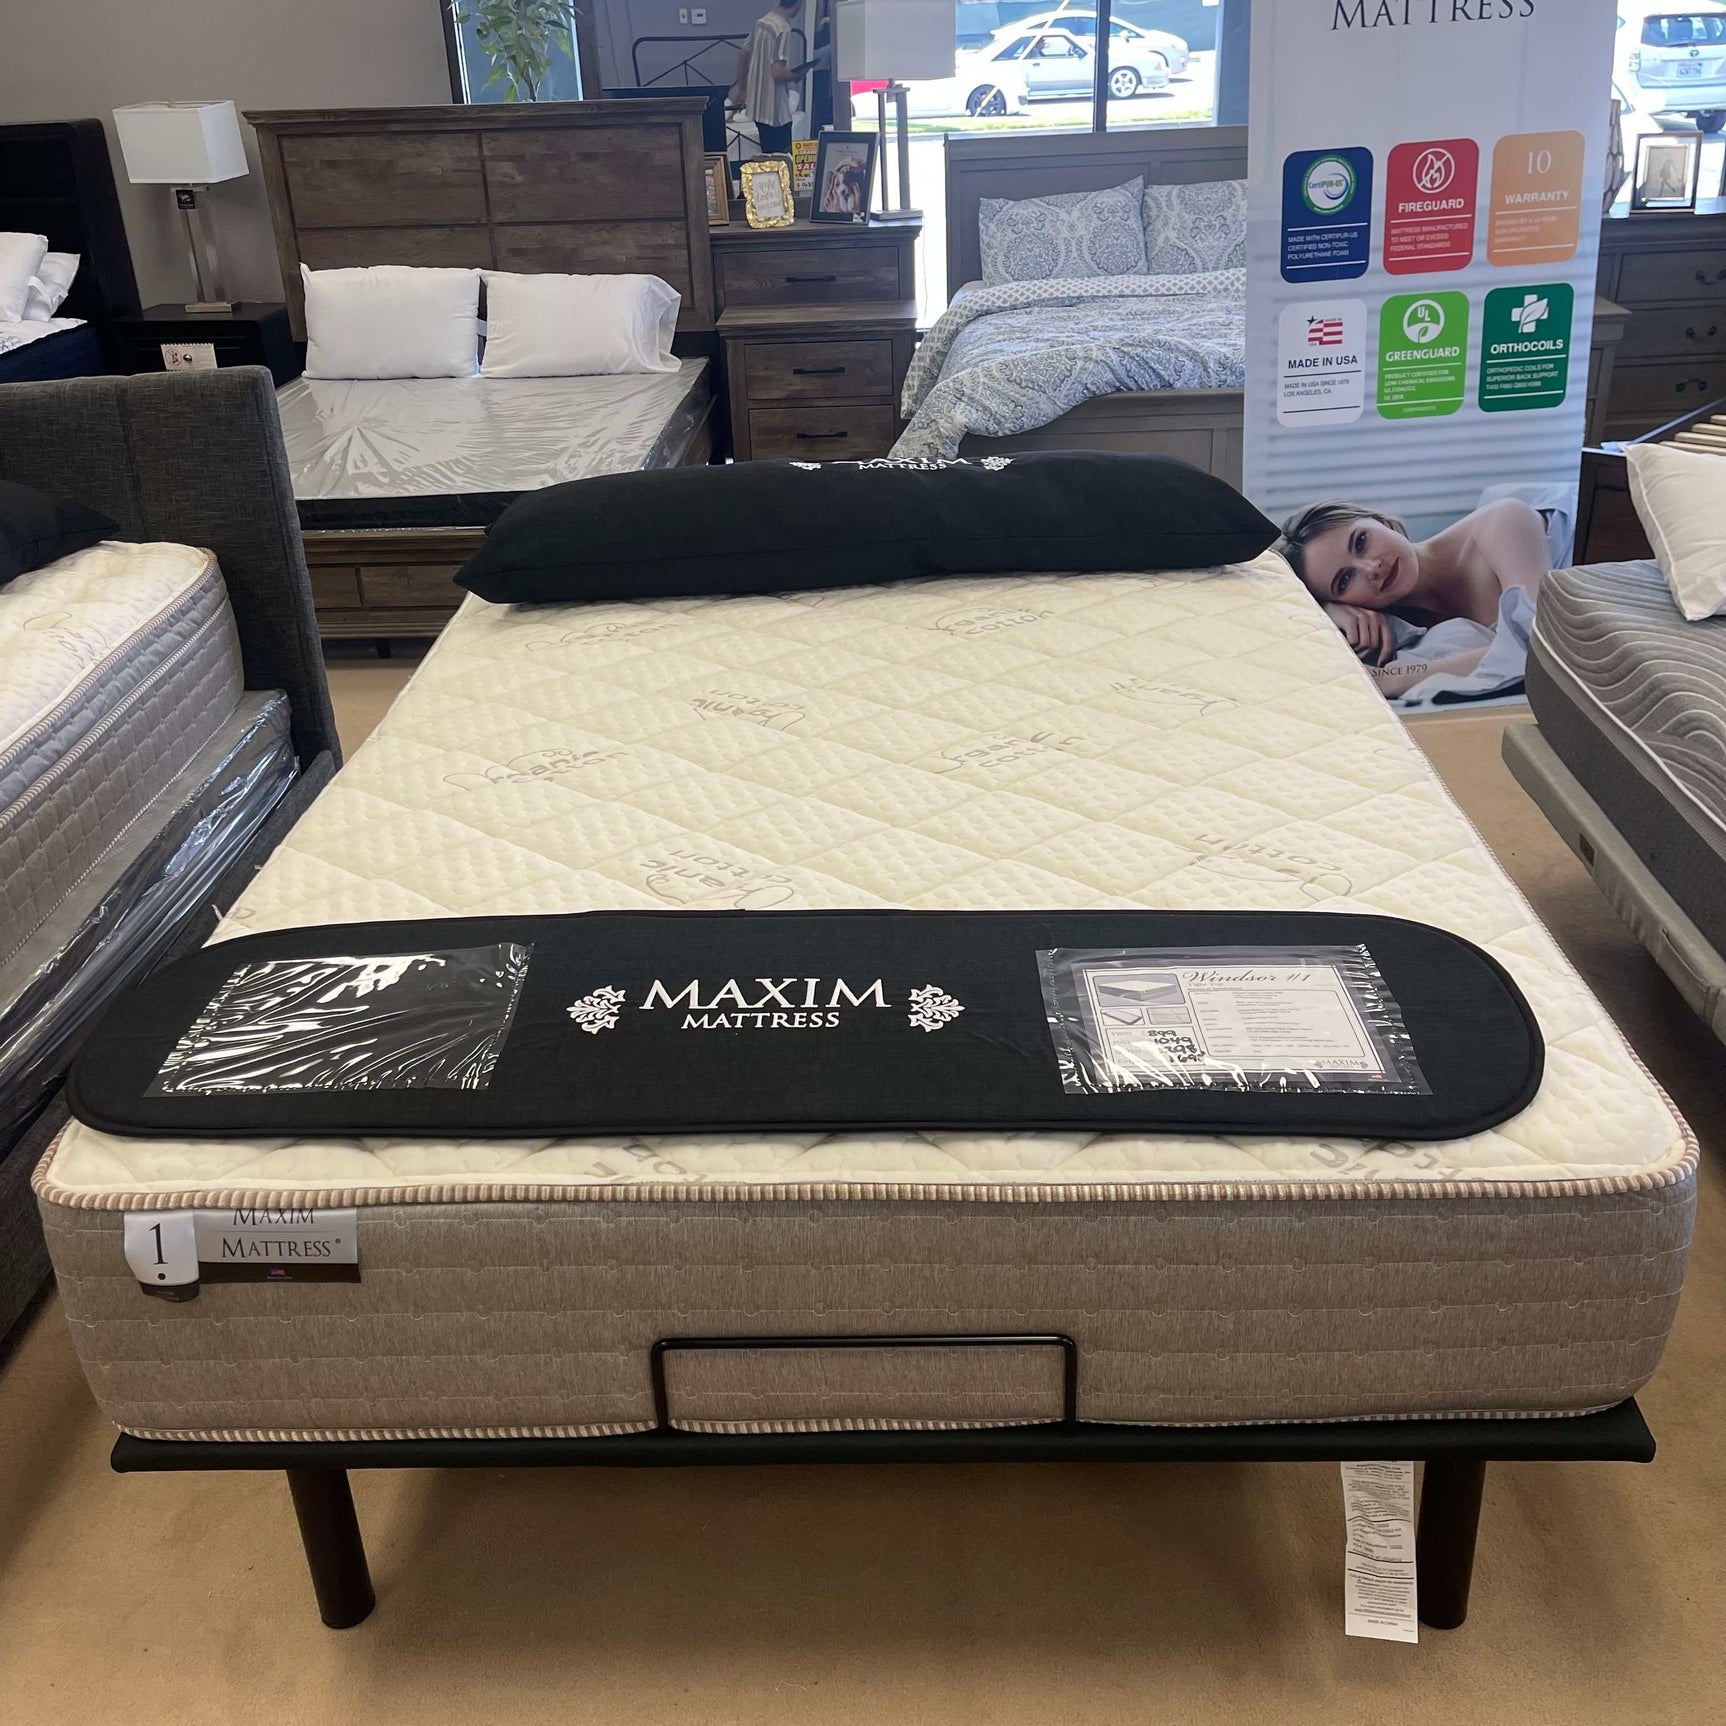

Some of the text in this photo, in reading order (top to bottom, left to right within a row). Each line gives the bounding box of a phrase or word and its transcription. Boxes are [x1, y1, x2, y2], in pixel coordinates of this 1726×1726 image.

[1527, 149, 1552, 174] 10
[1504, 190, 1570, 205] WARRANTY
[1398, 198, 1464, 213] FIREGUARD
[1417, 306, 1430, 322] UL
[1386, 346, 1460, 362] GREENGUARD
[1490, 339, 1564, 354] ORTHOCOILS
[1288, 355, 1358, 368] MADE IN USA
[1371, 664, 1428, 677] SINCE 1979
[1182, 969, 1278, 983] Windsor
[638, 978, 892, 1010] MAXIM
[681, 1012, 840, 1030] MATTRESS
[1154, 1036, 1193, 1044] 1049
[233, 1208, 315, 1226] MAXIM
[149, 1222, 168, 1265] 1
